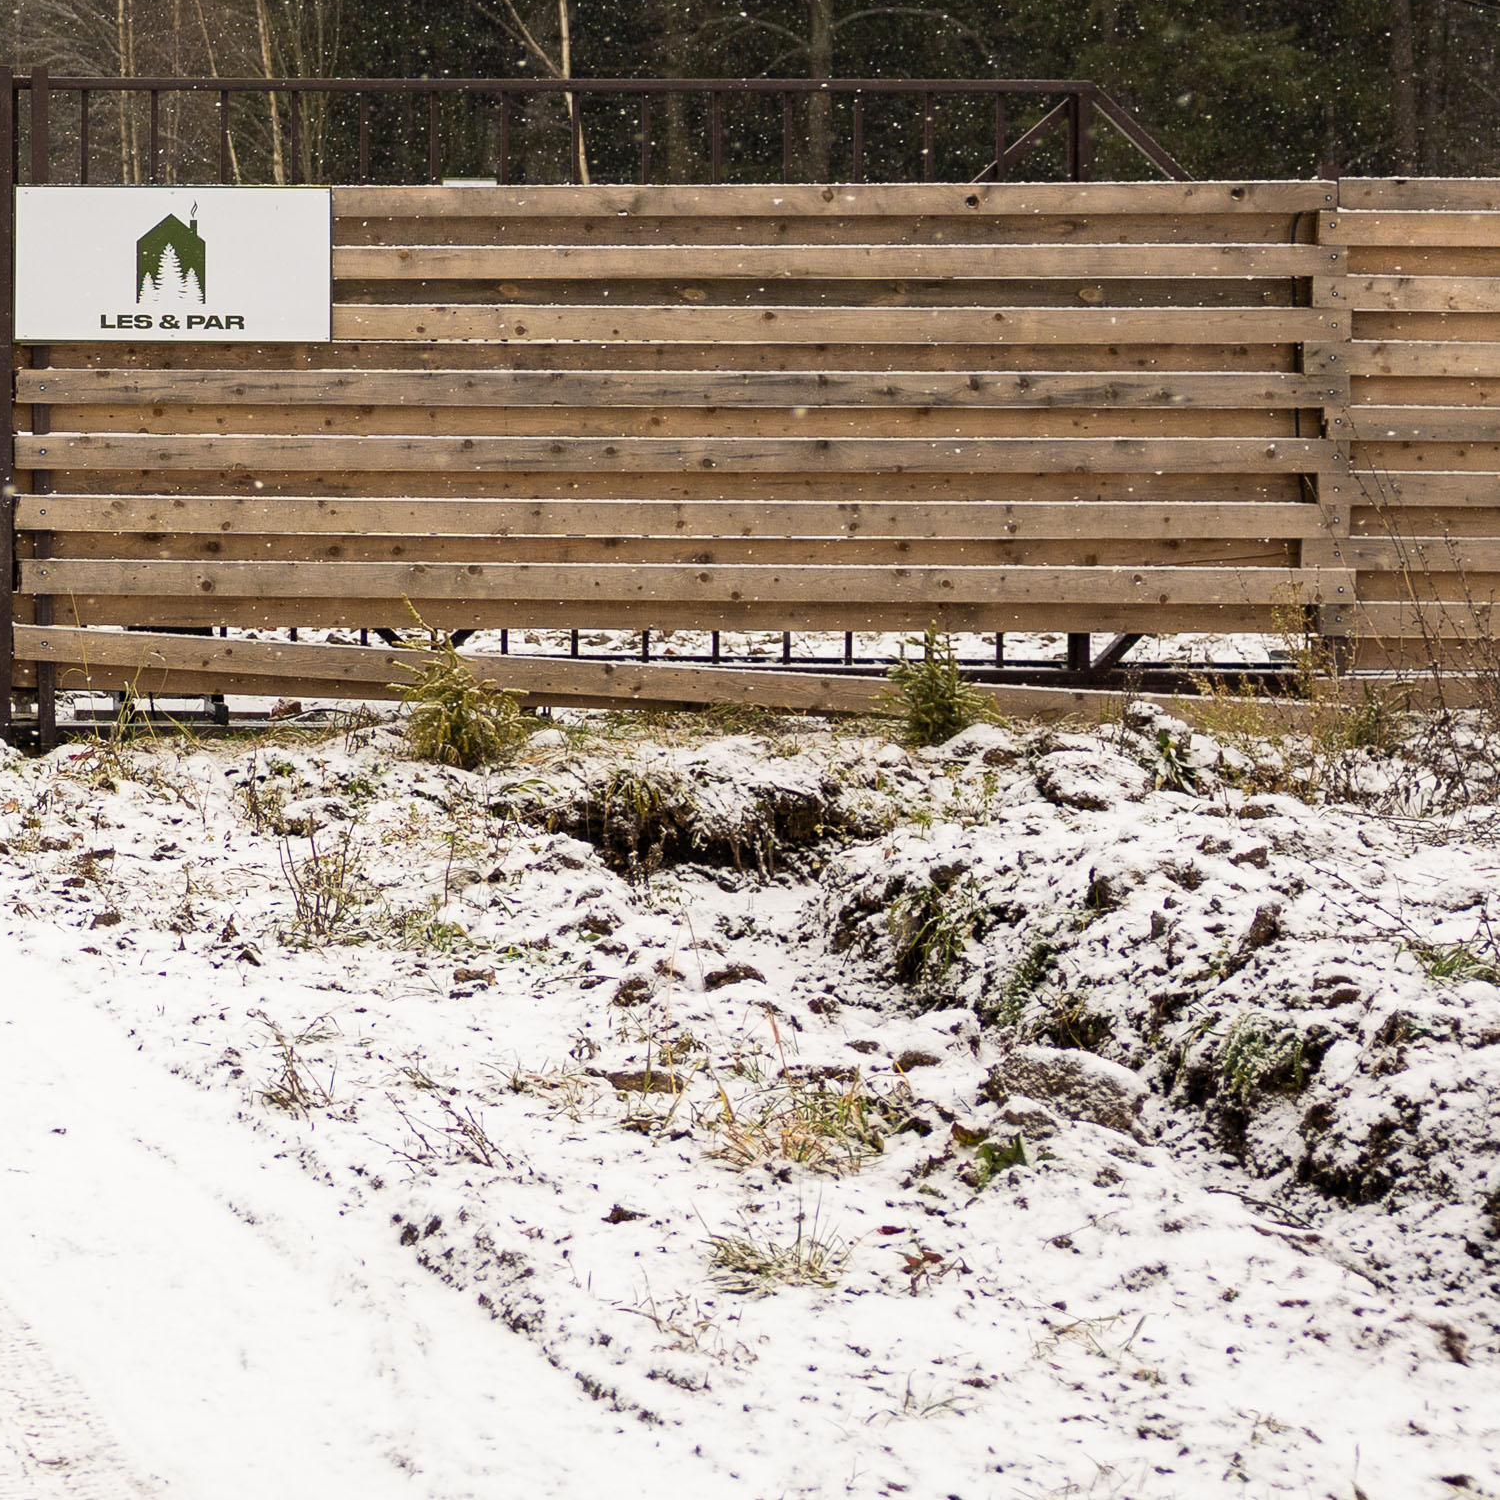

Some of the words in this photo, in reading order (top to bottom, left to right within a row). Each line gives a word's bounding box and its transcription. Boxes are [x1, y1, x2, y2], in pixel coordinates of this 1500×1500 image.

[100, 314, 153, 329] LES
[158, 314, 180, 329] &
[186, 315, 245, 329] PAR
